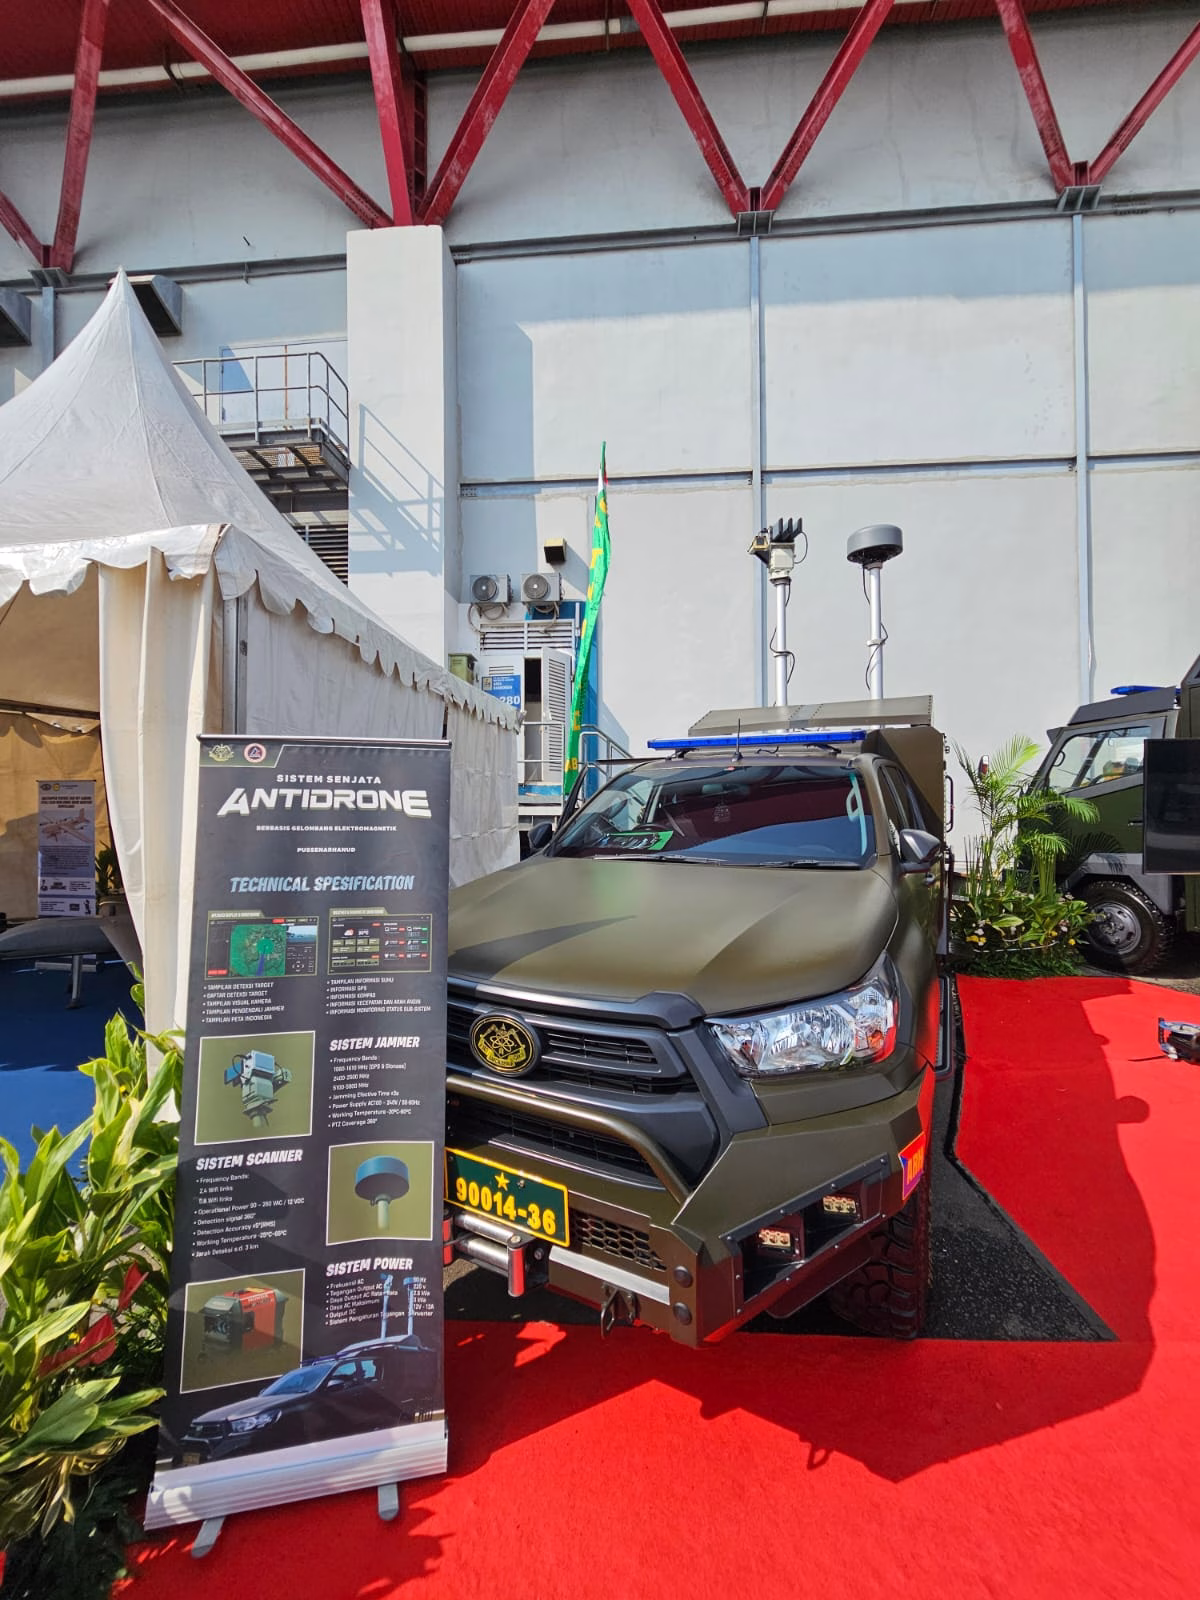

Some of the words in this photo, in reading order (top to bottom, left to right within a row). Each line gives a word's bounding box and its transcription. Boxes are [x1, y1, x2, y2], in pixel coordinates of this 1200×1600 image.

[500, 696, 520, 705] 280
[276, 774, 323, 783] SISTEM
[326, 775, 381, 784] SENJATA
[216, 788, 432, 818] ANTIDRONE
[230, 876, 310, 893] TECHNICAL
[313, 875, 414, 891] SPESIFICATION
[329, 1037, 374, 1051] SISTEM
[374, 1036, 420, 1048] JAMMER
[334, 1056, 360, 1064] Frequency
[196, 1154, 244, 1171] SISTEM
[246, 1149, 303, 1166] SCANNER
[200, 1176, 229, 1184] Frequency
[198, 1206, 231, 1215] Operational
[456, 1177, 556, 1235] 90014-36
[197, 1227, 224, 1236] Detection
[225, 1224, 252, 1232] Accuracy
[221, 1233, 257, 1244] Temperature
[212, 1247, 233, 1255] Deteksi
[326, 1258, 372, 1277] SISTEM
[373, 1258, 413, 1270] POWER
